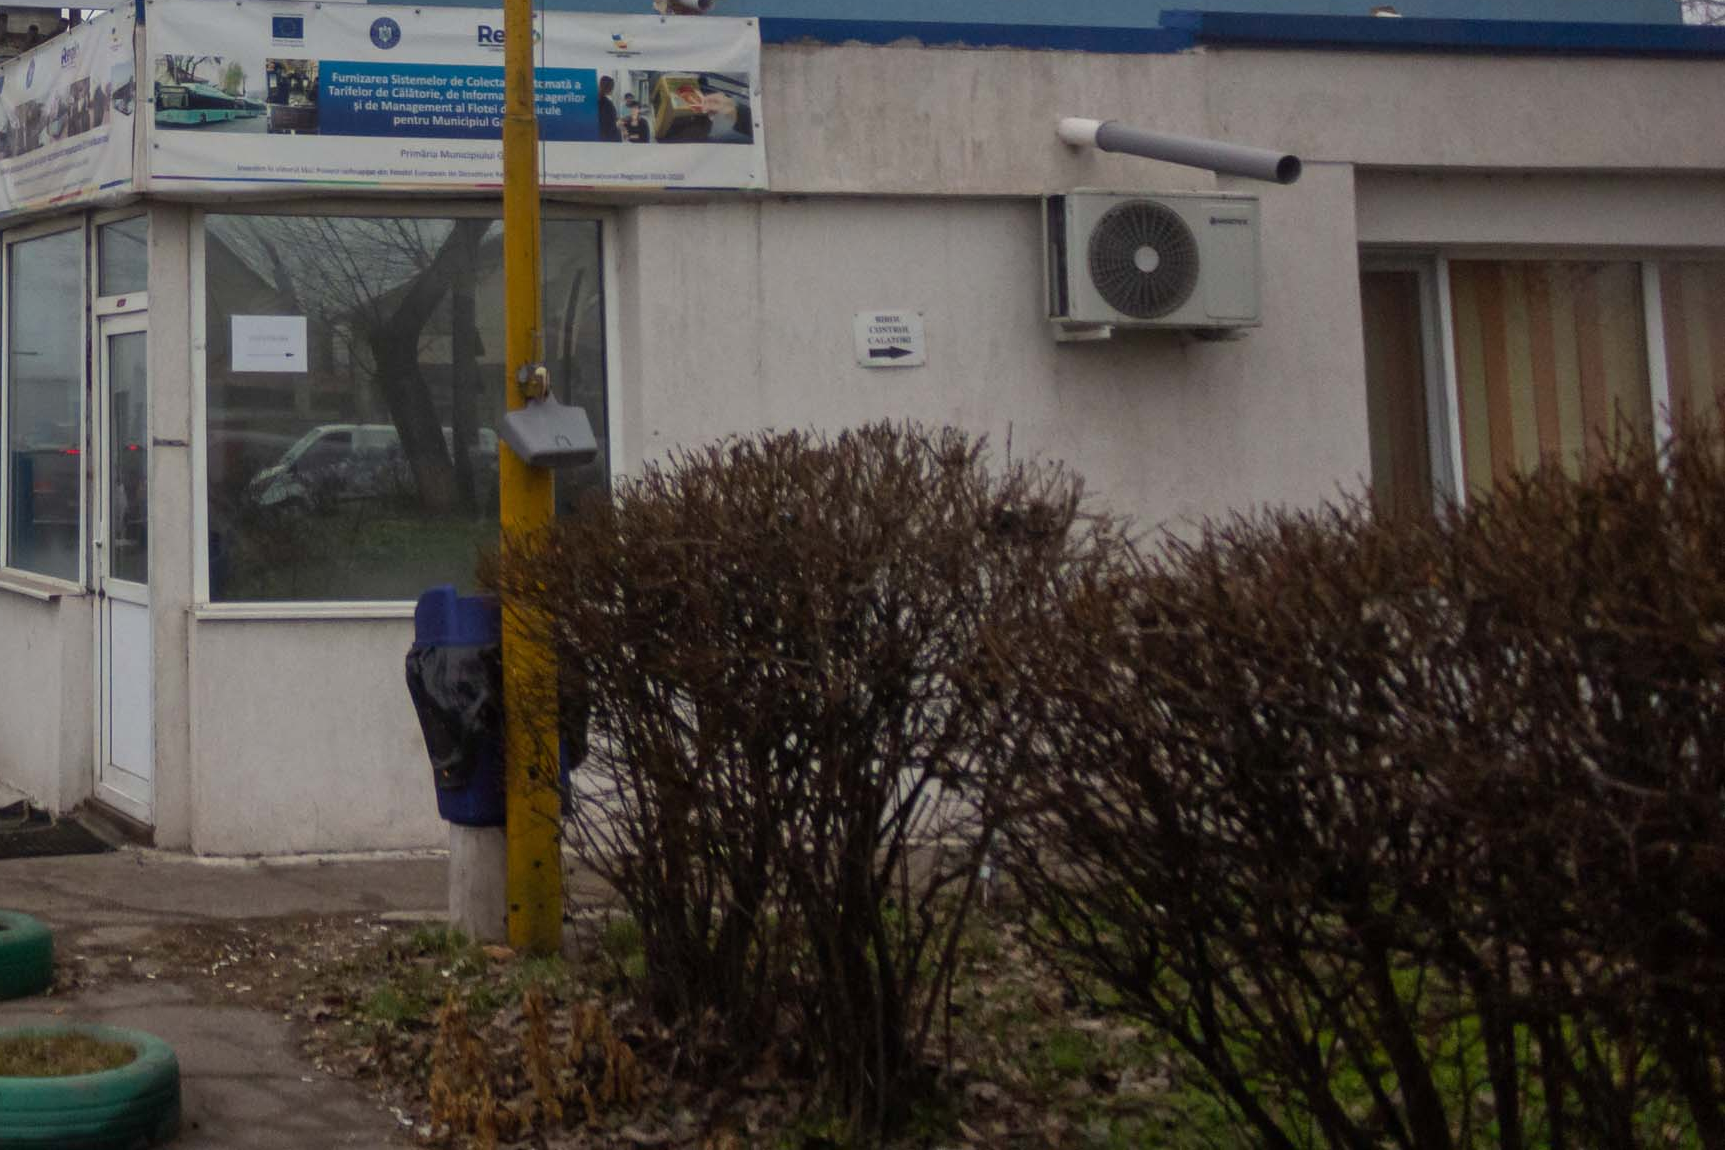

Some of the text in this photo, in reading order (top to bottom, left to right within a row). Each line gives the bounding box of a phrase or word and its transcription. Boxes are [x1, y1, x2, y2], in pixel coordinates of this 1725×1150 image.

[331, 72, 389, 84] Furnizarea
[391, 74, 447, 86] Sistemelor
[450, 75, 464, 86] de
[466, 77, 505, 88] Colecta
[328, 85, 373, 97] Tarifelor
[375, 86, 389, 98] de
[446, 88, 460, 99] de
[462, 90, 505, 101] Informa
[365, 100, 379, 111] de
[381, 101, 453, 114] Management
[455, 102, 466, 113] al
[468, 103, 498, 114] Flotei
[393, 115, 430, 127] pentru
[432, 115, 489, 129] Municipiul
